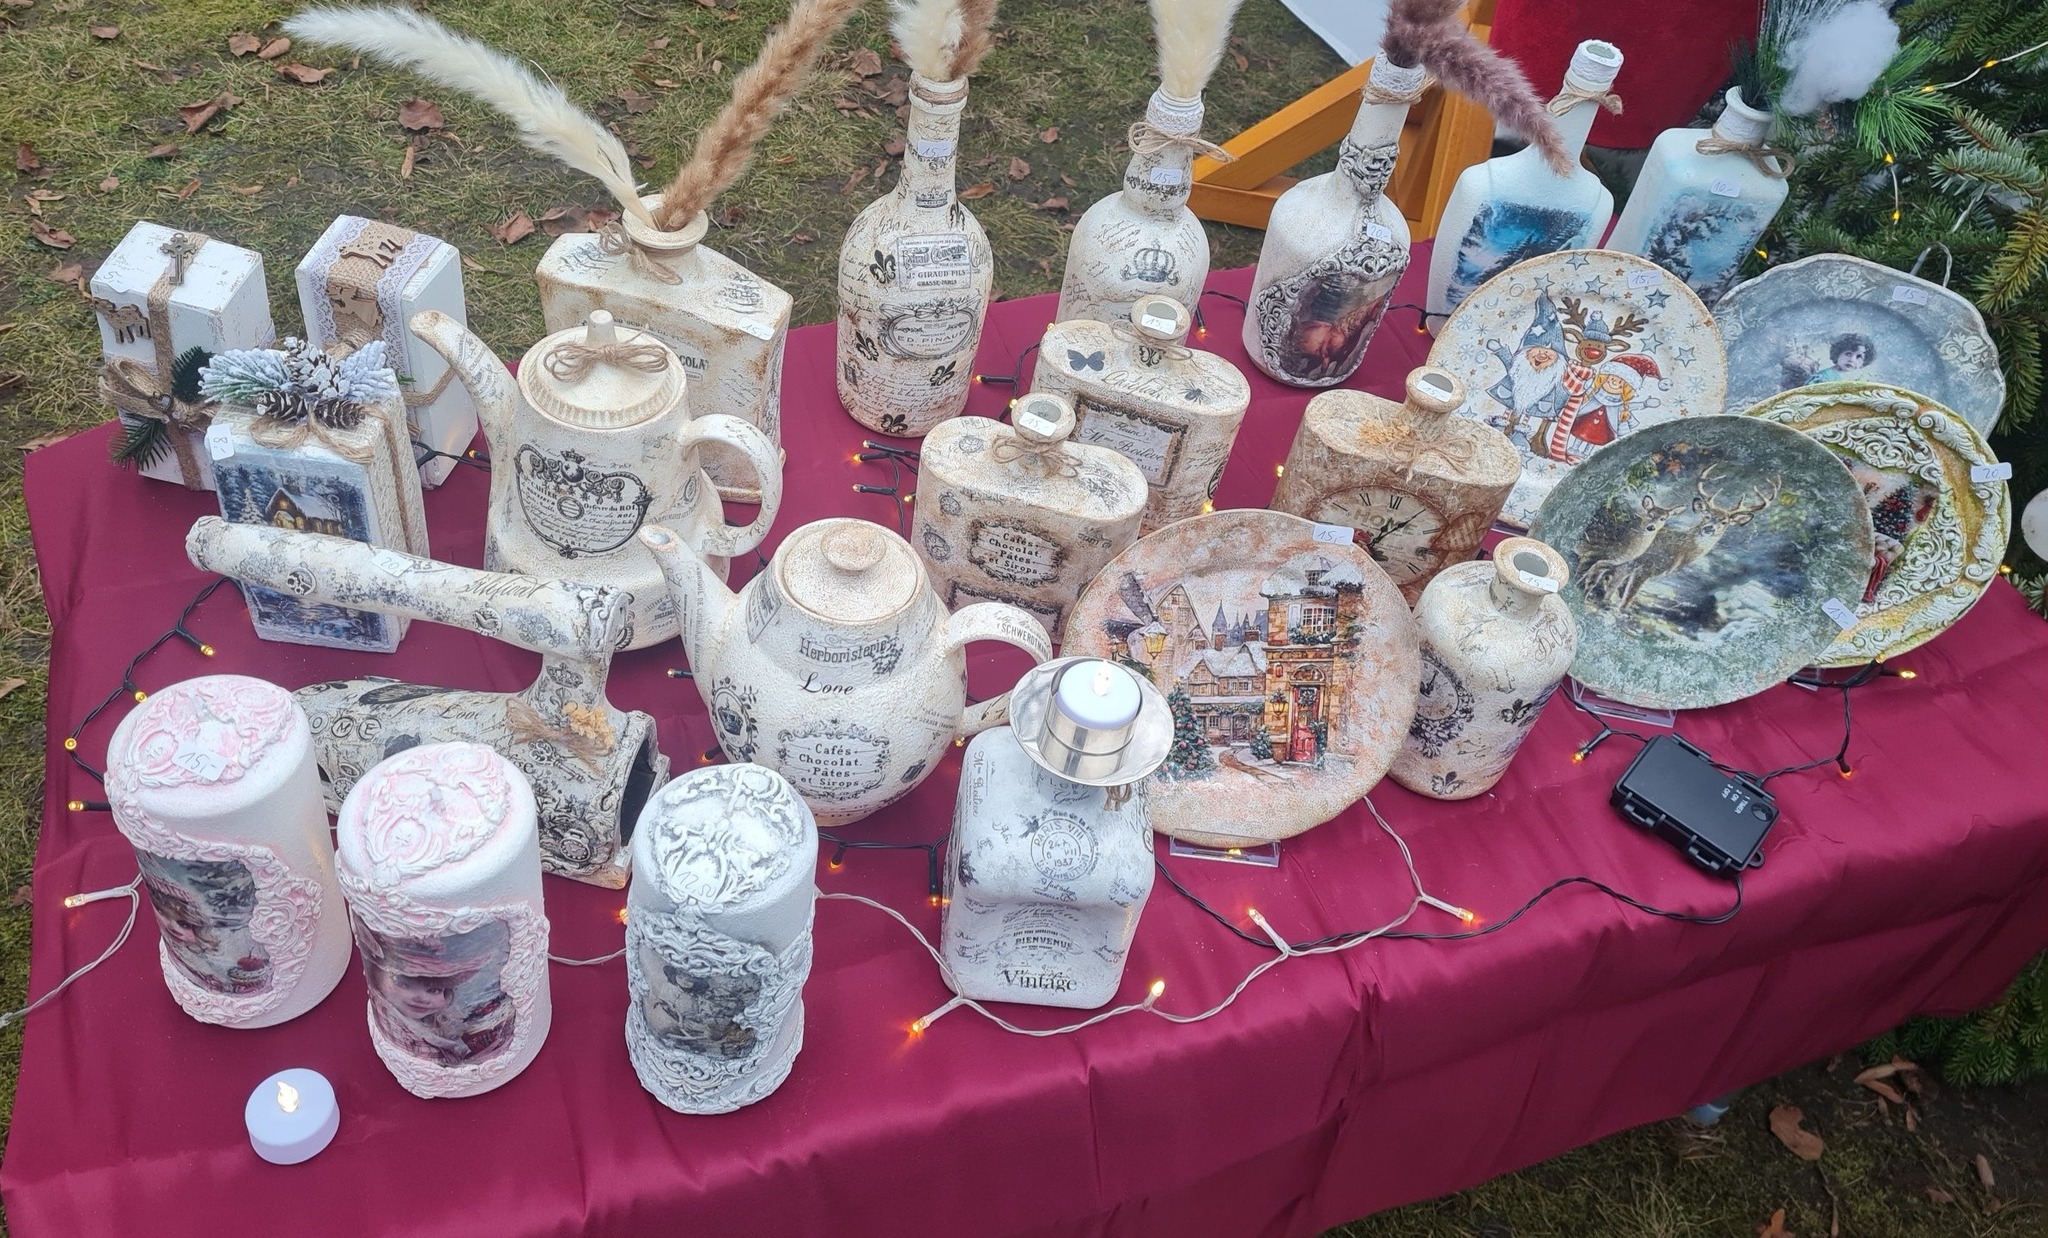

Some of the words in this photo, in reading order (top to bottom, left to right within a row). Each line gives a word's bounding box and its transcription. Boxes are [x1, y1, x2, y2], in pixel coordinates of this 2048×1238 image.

[921, 329, 966, 343] PINAUD
[1003, 532, 1033, 547] Cafés
[988, 557, 998, 565] et
[1000, 551, 1031, 565] Pâtes
[800, 635, 887, 664] Herboristerie
[815, 743, 851, 755] Cafés
[812, 766, 850, 778] Pâtes
[1721, 787, 1731, 799] OFF
[1730, 793, 1739, 802] ON
[1734, 799, 1749, 814] TIMER
[1034, 820, 1062, 847] PARIS
[1054, 858, 1074, 867] 1937
[1014, 936, 1073, 949] BIENVENUE
[1000, 968, 1078, 993] Vintage
